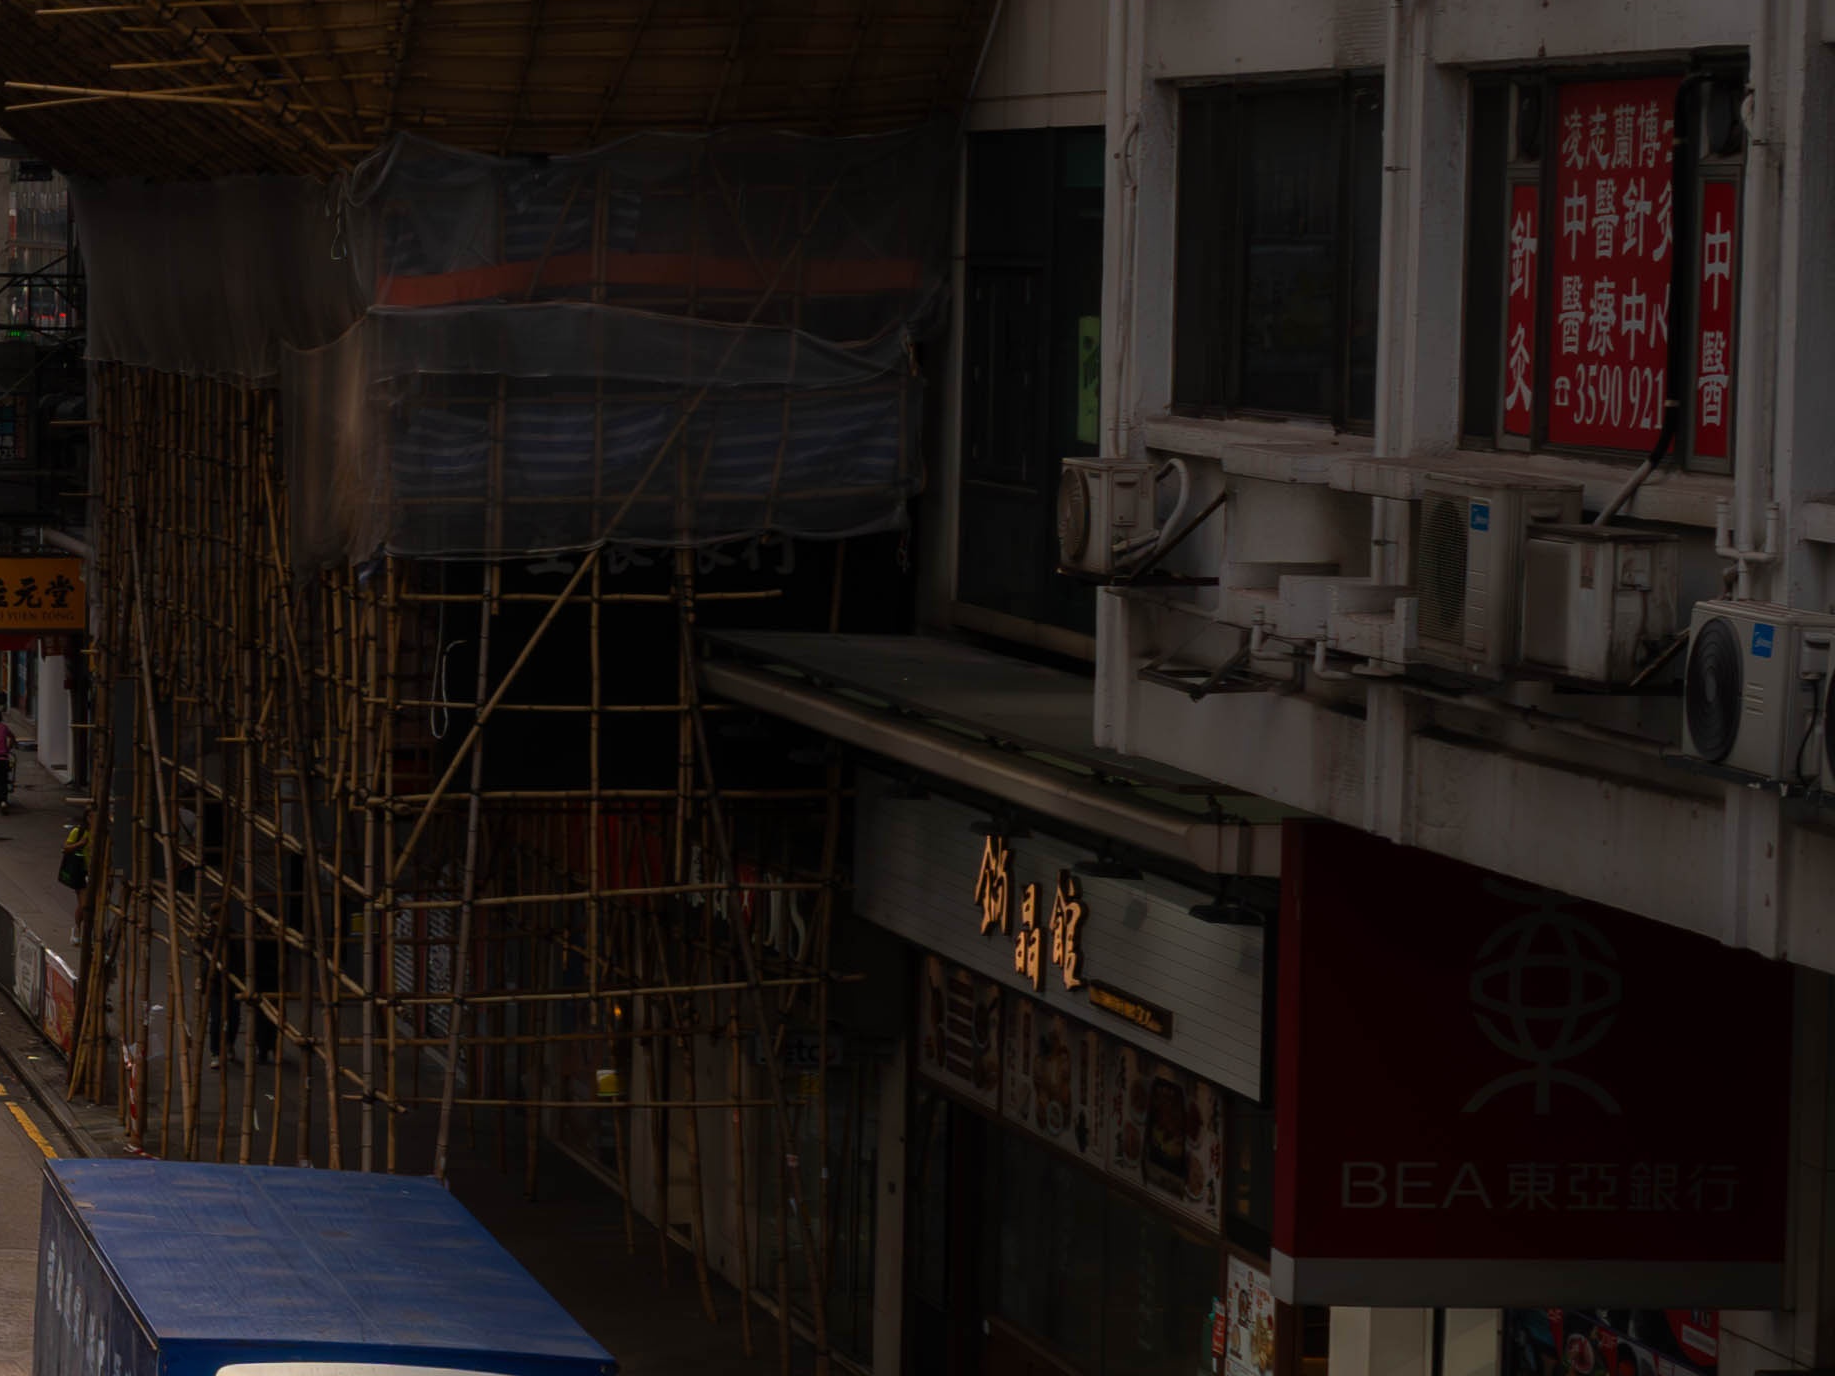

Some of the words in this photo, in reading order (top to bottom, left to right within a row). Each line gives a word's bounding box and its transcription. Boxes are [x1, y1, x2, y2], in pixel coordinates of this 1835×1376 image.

[1505, 209, 1538, 414] 針灸
[1695, 212, 1733, 431] 中醫
[1574, 362, 1621, 426] 3590
[7, 610, 39, 621] YUEN
[1341, 1161, 1495, 1211] BEA
[1507, 1160, 1741, 1216] 東亞銀行
